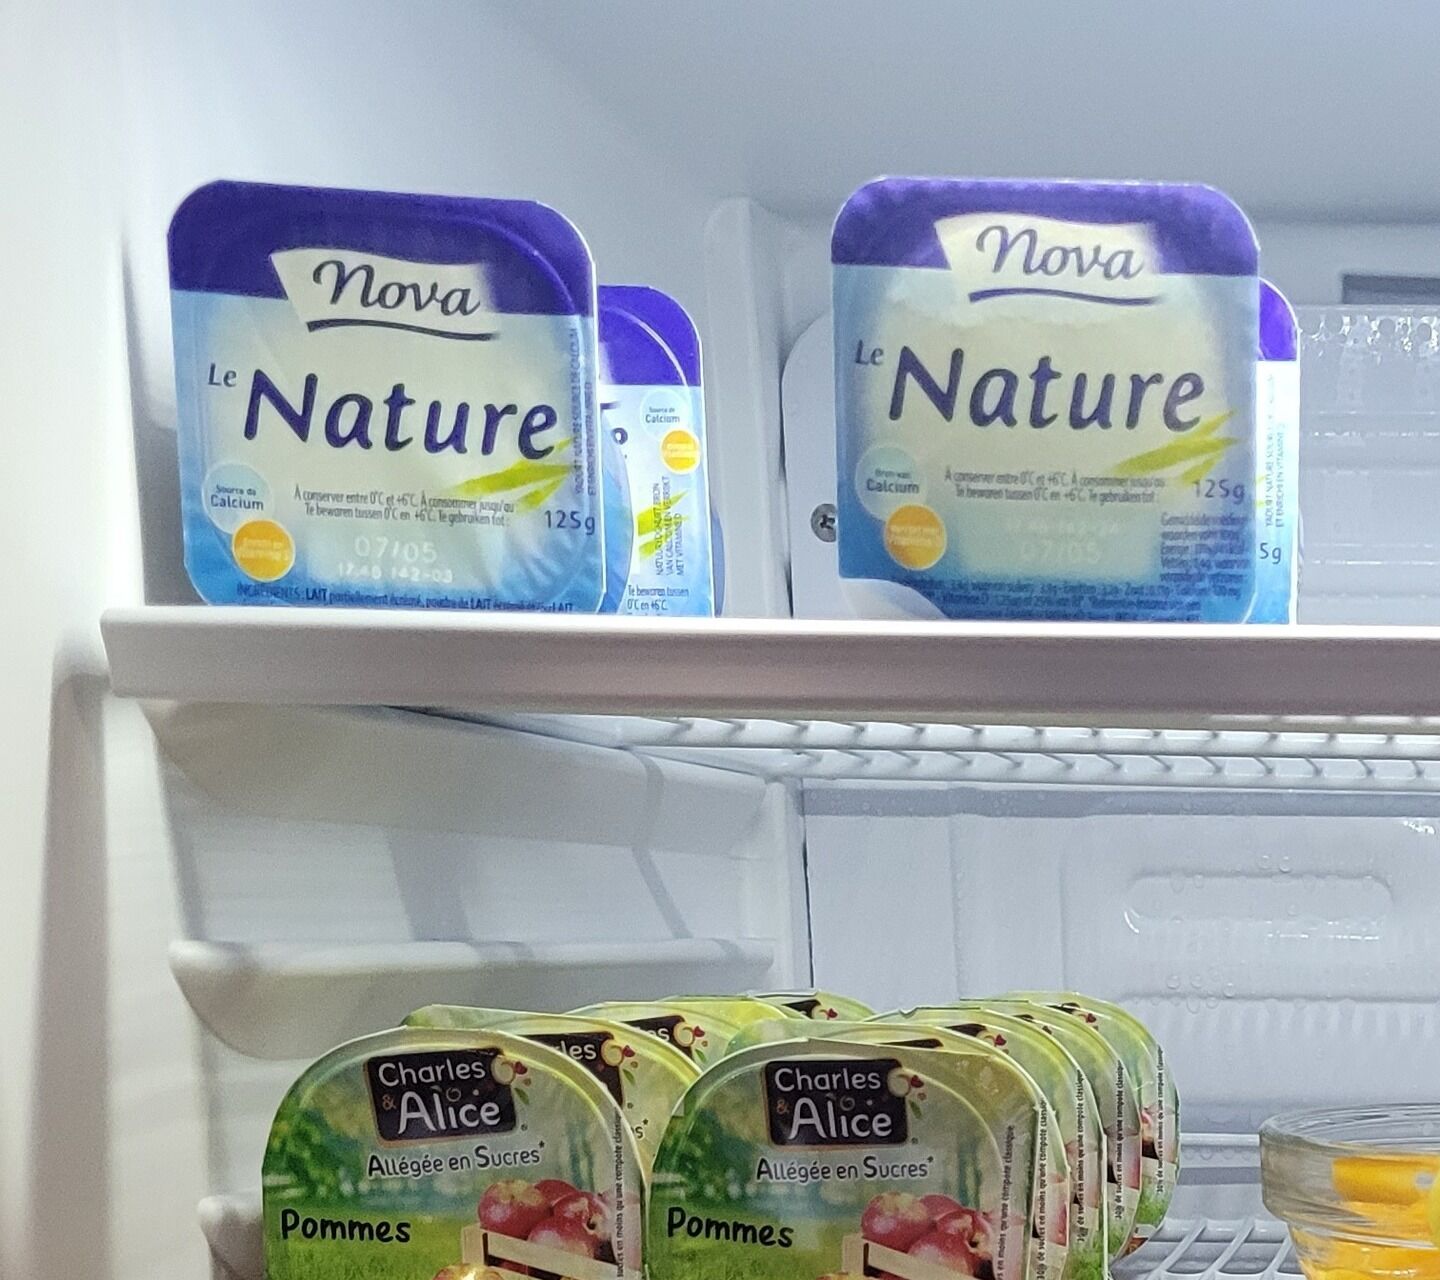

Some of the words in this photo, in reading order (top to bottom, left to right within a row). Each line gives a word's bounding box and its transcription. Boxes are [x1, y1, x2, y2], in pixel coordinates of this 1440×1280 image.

[976, 225, 1143, 281] Nova
[313, 258, 481, 317] Nova
[855, 340, 884, 366] Le
[208, 363, 237, 389] Le
[888, 345, 1205, 432] Nature
[244, 369, 559, 460] Nature
[645, 414, 680, 424] Calcium
[346, 491, 368, 504] entre
[866, 478, 919, 494] Calcium
[1192, 478, 1245, 506] 125g
[210, 494, 264, 511] Calcium
[315, 504, 353, 518] bewaren
[544, 508, 596, 536] 125g
[378, 1058, 486, 1087] Charles
[774, 1067, 881, 1092] Charles
[398, 1091, 502, 1135] Alice
[1116, 1091, 1124, 1117] compote
[788, 1097, 892, 1140] Alice
[1039, 1129, 1047, 1161] compote
[368, 1154, 444, 1178] Allégée
[449, 1154, 471, 1171] en
[615, 1145, 624, 1181] compote
[757, 1157, 831, 1183] Allégée
[836, 1163, 858, 1179] en
[1038, 1191, 1046, 1213] moins
[281, 1208, 412, 1244] Pommes
[667, 1205, 794, 1249] Pommes
